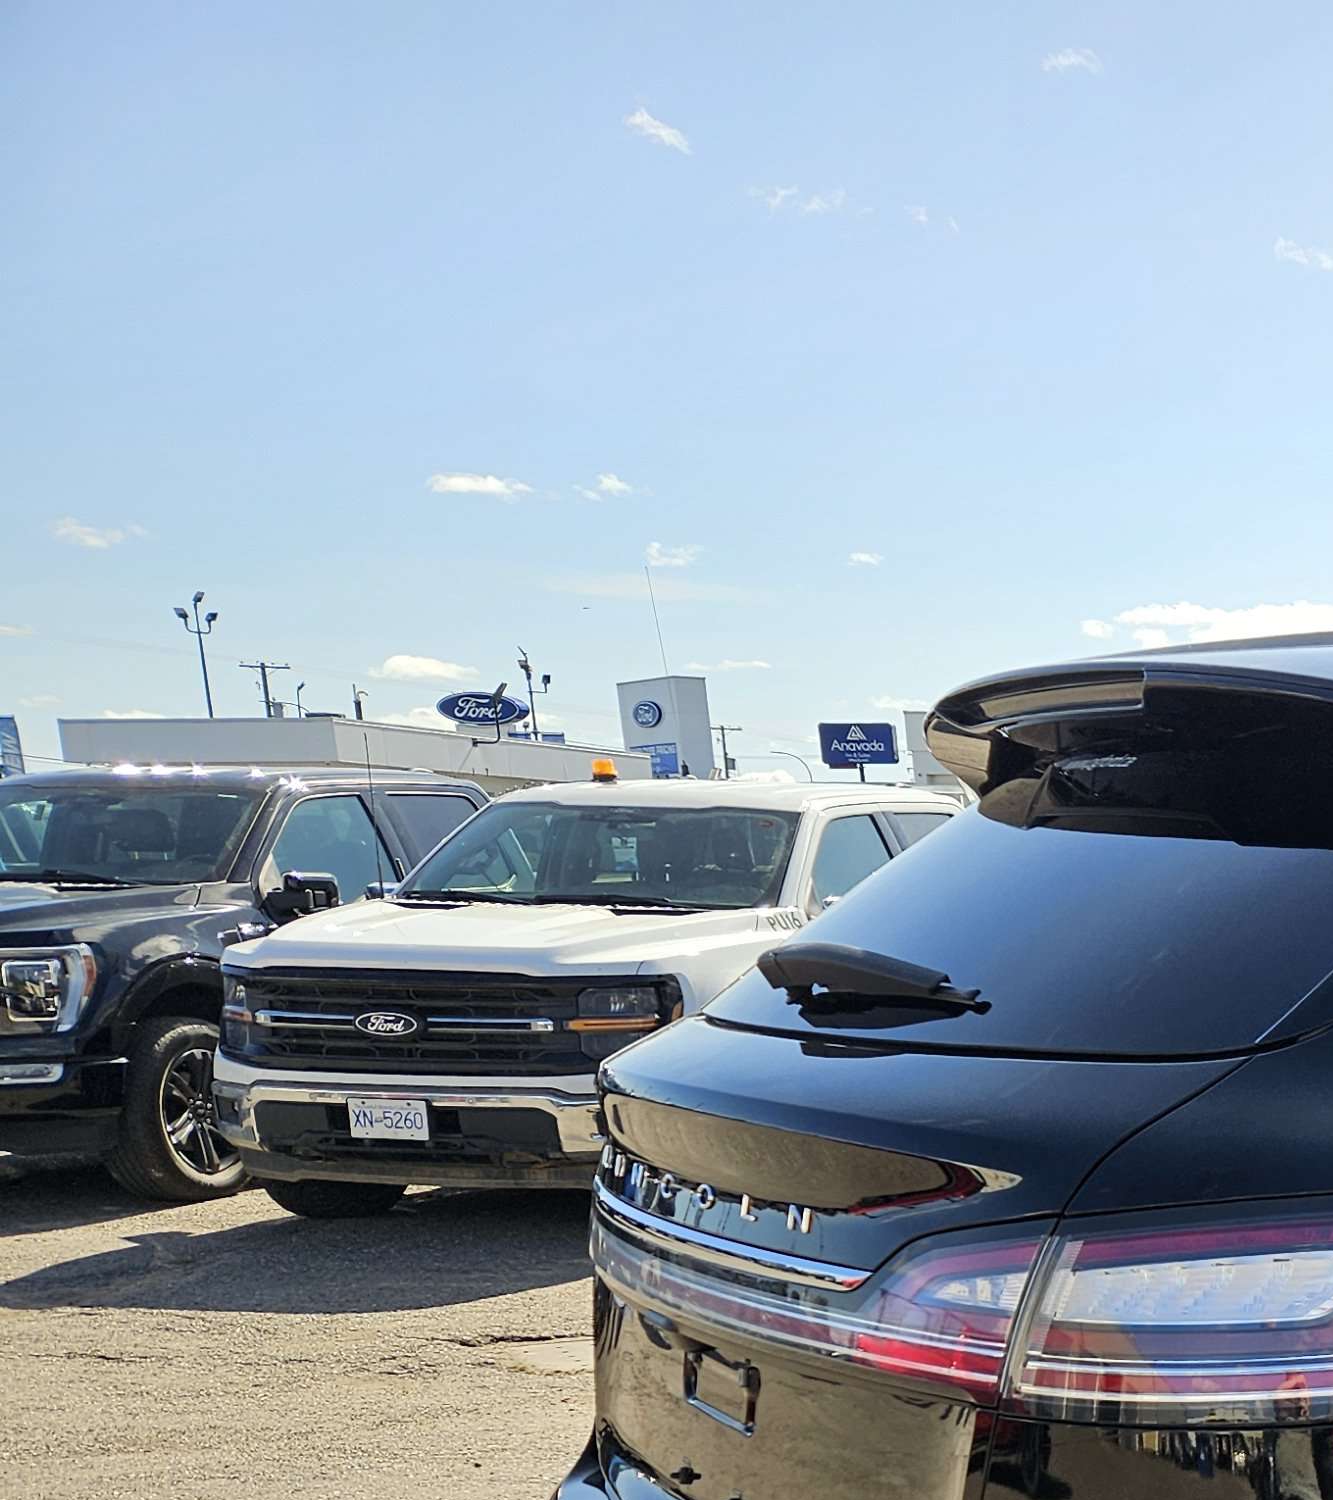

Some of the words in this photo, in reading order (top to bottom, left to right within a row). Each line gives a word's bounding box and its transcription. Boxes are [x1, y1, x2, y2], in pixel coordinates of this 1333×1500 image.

[454, 697, 502, 719] Ford
[831, 739, 885, 751] Anavada
[766, 911, 803, 932] PU16
[367, 1015, 405, 1032] Ford
